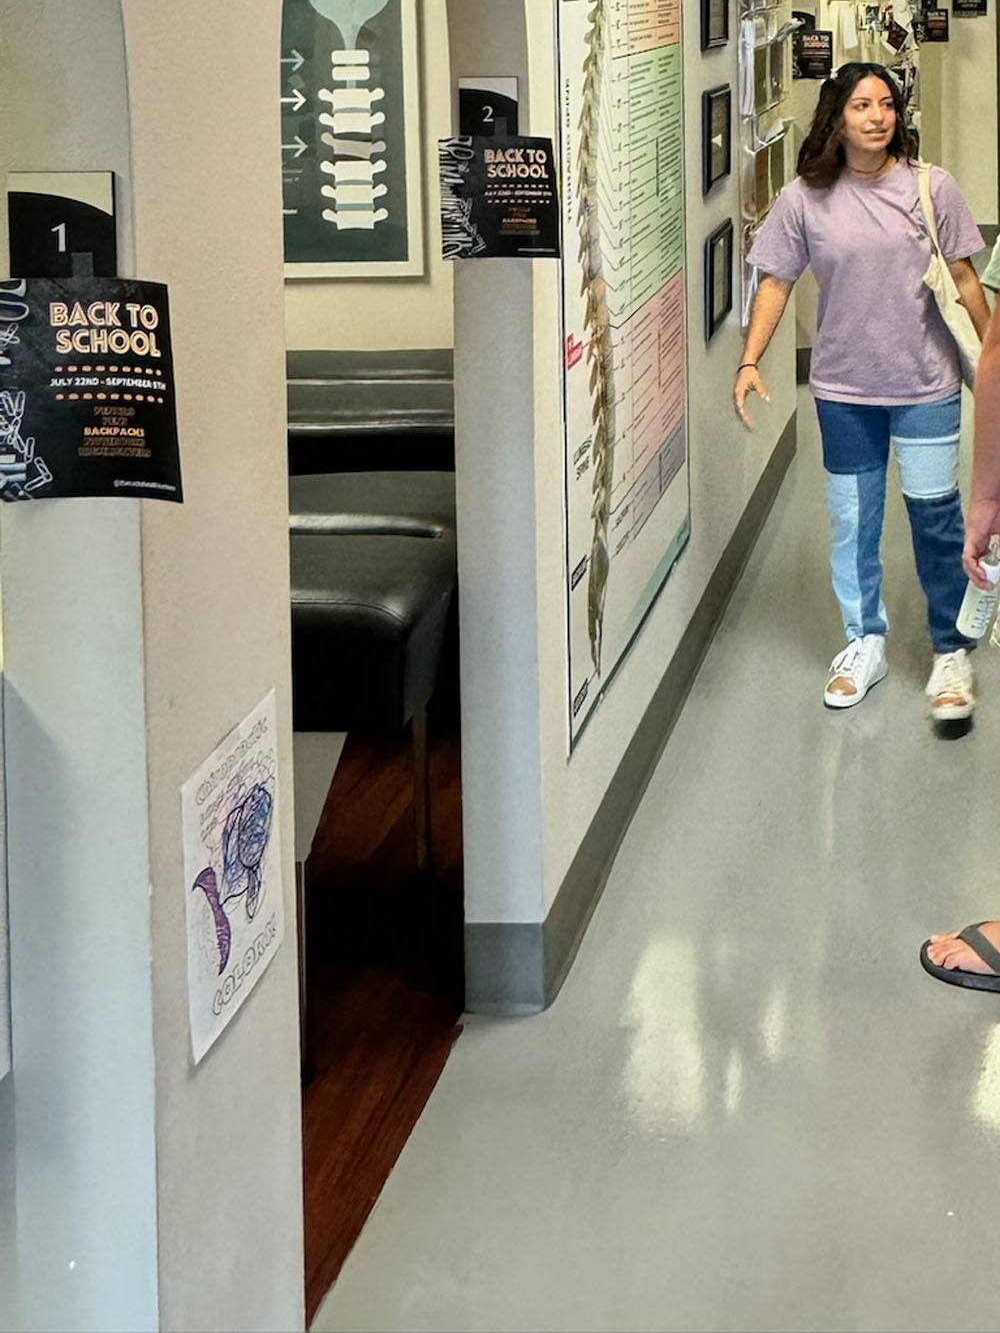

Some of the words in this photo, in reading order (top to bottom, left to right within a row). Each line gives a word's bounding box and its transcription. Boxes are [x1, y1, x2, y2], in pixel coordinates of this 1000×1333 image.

[481, 105, 495, 123] 2
[484, 149, 525, 164] BACK
[526, 149, 547, 164] TO
[487, 164, 549, 179] SCHOOL
[51, 222, 67, 253] 1
[49, 301, 122, 327] BACK
[126, 302, 159, 330] TO
[55, 328, 162, 358] SCHOOL
[50, 377, 73, 387] JULY
[74, 377, 99, 387] 22ND
[105, 377, 153, 389] SEPTEMBER
[83, 426, 145, 438] BACKPACKS
